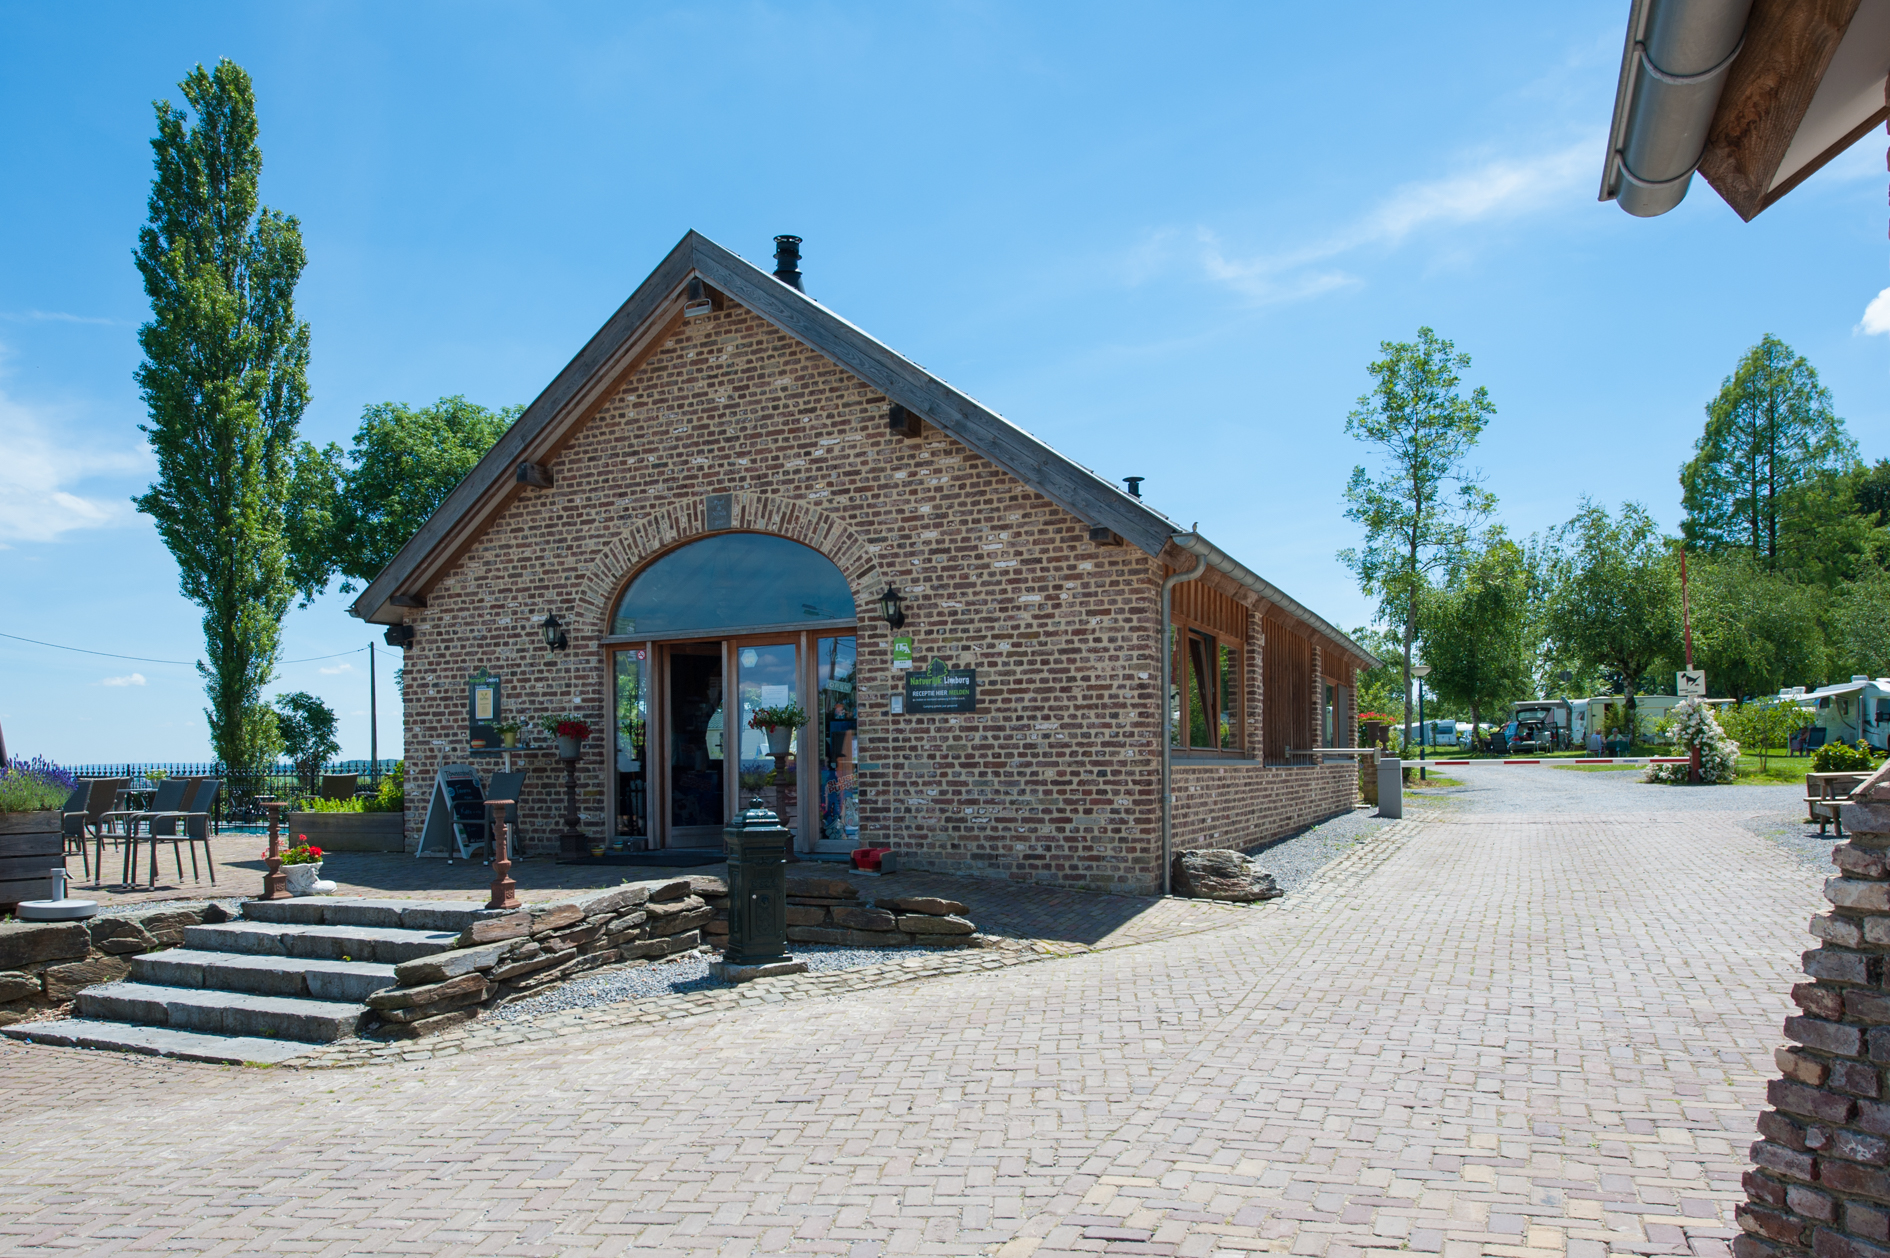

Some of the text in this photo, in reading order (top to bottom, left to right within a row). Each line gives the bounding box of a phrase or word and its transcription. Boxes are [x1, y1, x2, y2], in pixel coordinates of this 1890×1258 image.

[943, 676, 970, 685] Limburg
[829, 682, 850, 691] OPEN
[827, 773, 858, 788] SLUSH
